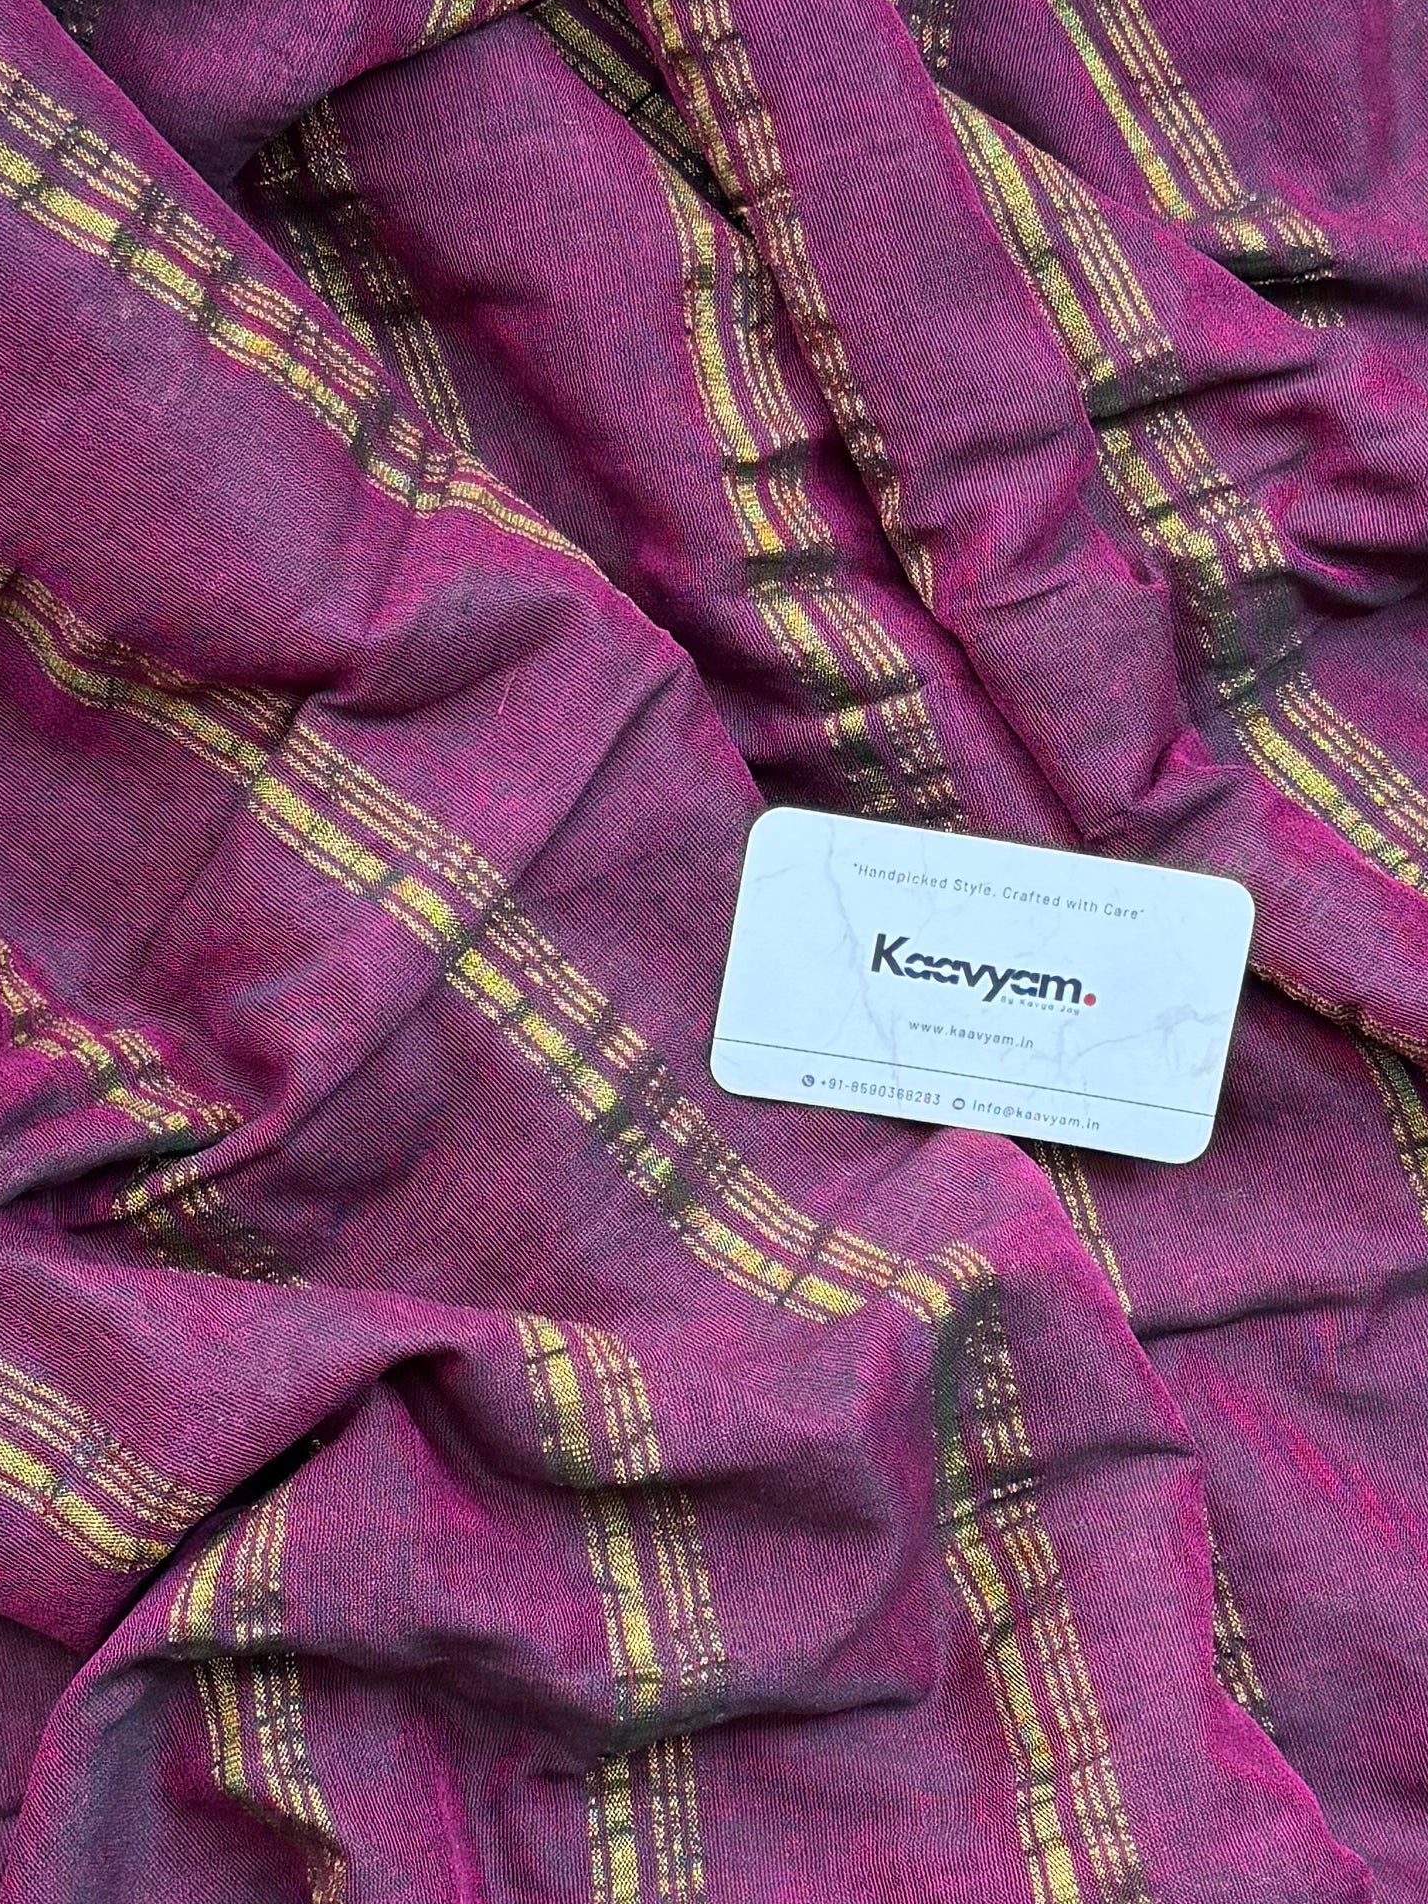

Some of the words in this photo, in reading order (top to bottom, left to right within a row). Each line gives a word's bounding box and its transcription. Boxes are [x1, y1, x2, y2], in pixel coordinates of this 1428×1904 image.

[1003, 886, 1061, 907] Crafted
[1066, 898, 1098, 913] with
[908, 1020, 1034, 1049] www.kaavyam.in
[972, 1099, 1100, 1131] info@kaavyam.in
